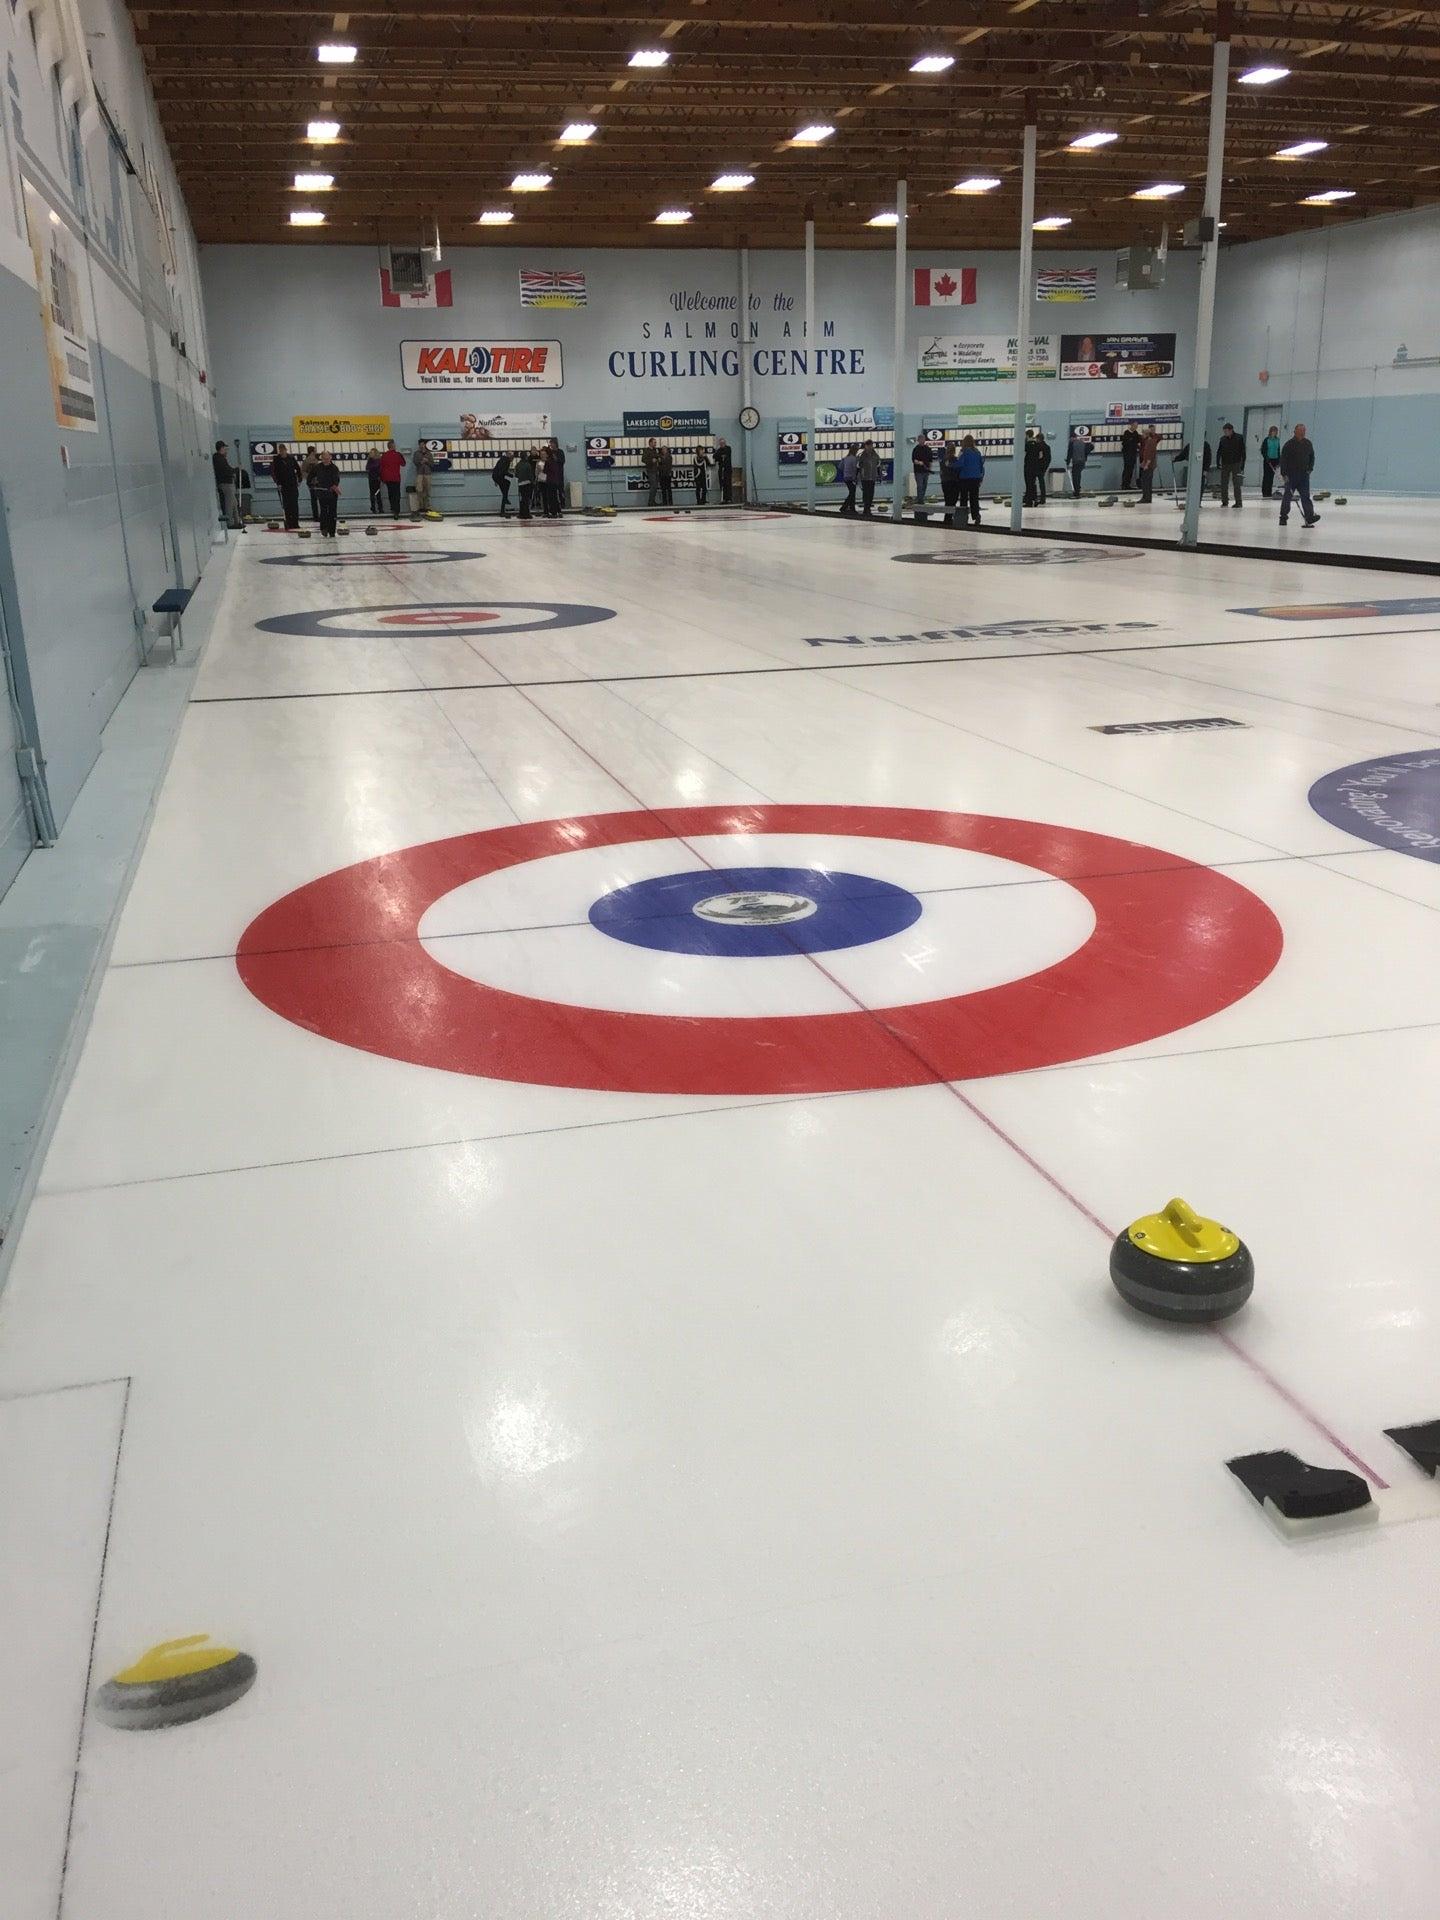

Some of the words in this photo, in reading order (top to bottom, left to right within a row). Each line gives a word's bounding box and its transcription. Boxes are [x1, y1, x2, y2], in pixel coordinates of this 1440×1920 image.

[670, 290, 737, 311] Welcome
[748, 293, 760, 311] to
[774, 292, 794, 311] the
[642, 321, 758, 339] SALMON
[417, 347, 472, 373] KAL
[490, 347, 548, 373] TIRE
[608, 350, 739, 377] CURLING
[753, 349, 865, 375] CENTRE
[1125, 403, 1150, 411] Lakeside
[626, 419, 658, 427] LAKESIDE
[932, 431, 938, 439] 5
[1079, 426, 1084, 435] 6
[787, 434, 794, 442] 4
[432, 441, 438, 450] 2
[595, 439, 602, 447] 3
[261, 444, 267, 452] 1
[803, 621, 1159, 647] Nufloors
